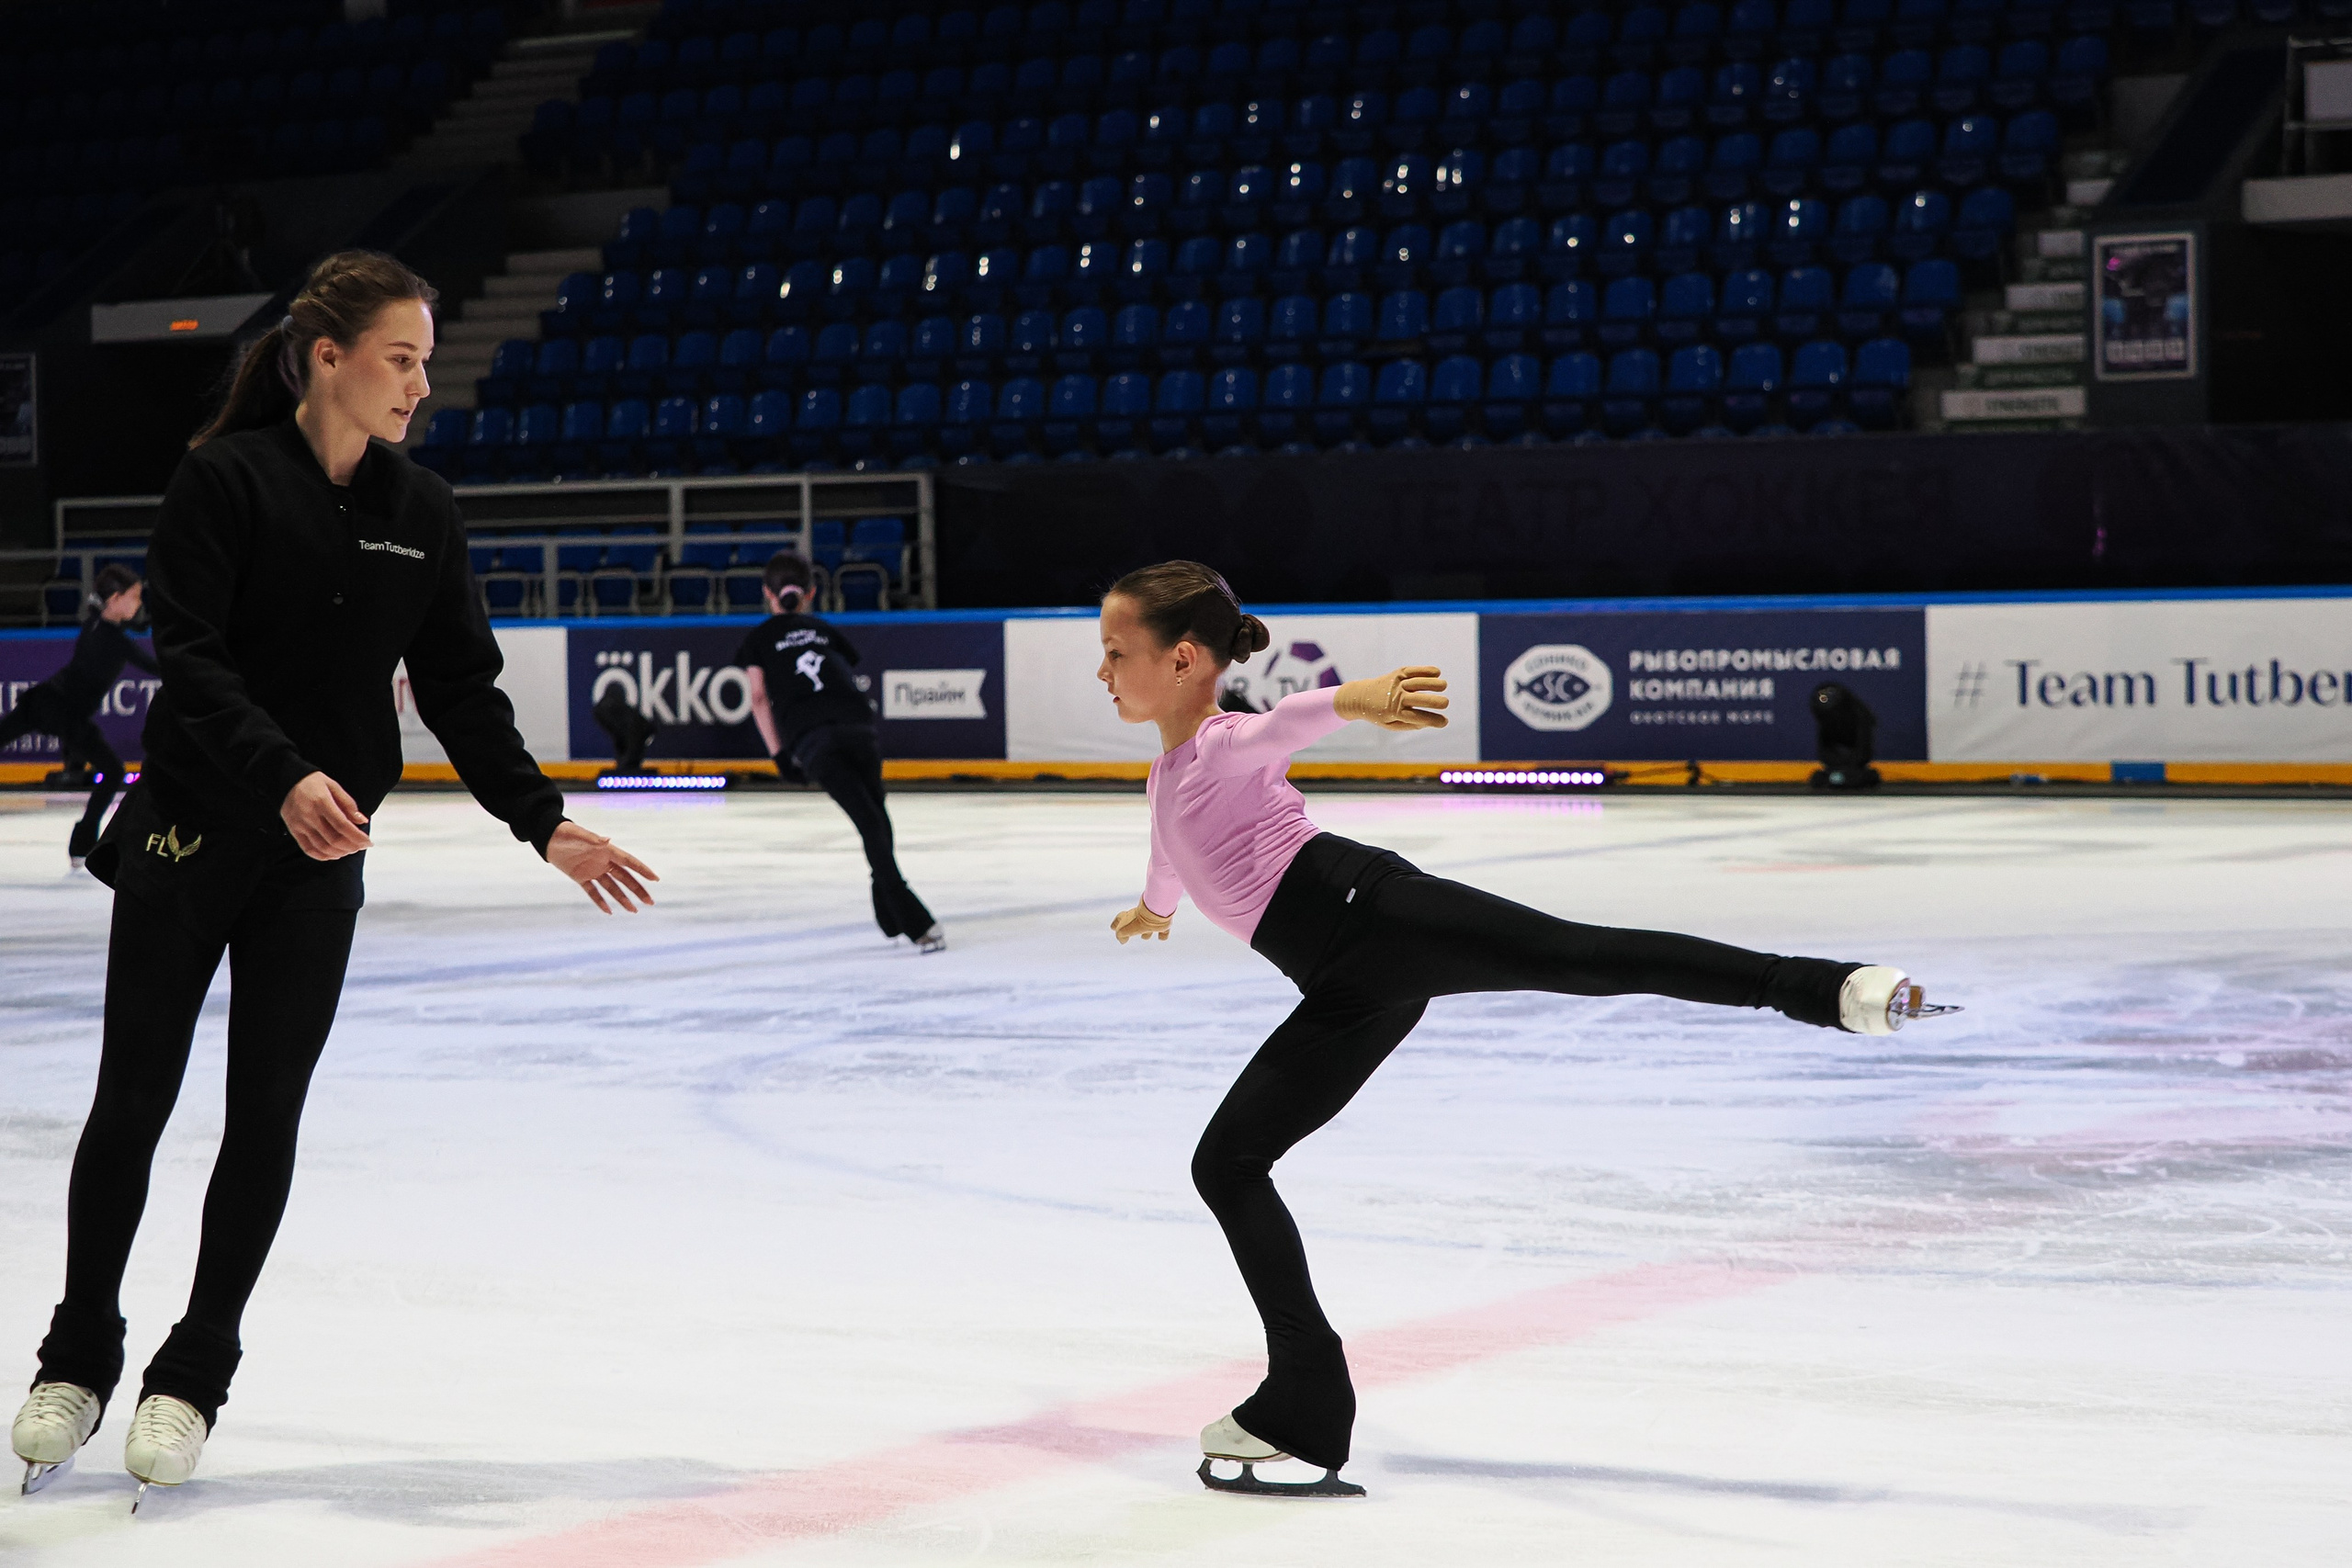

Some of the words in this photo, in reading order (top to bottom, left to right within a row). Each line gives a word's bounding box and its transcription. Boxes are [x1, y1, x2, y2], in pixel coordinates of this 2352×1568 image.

[358, 539, 384, 551] Team
[1629, 647, 1901, 671] РЫБОПРОМЫСЛОВАЯ
[1629, 678, 1775, 700] КОМПАНИЯ
[2004, 659, 2157, 707] Team
[145, 825, 202, 863] FLY
